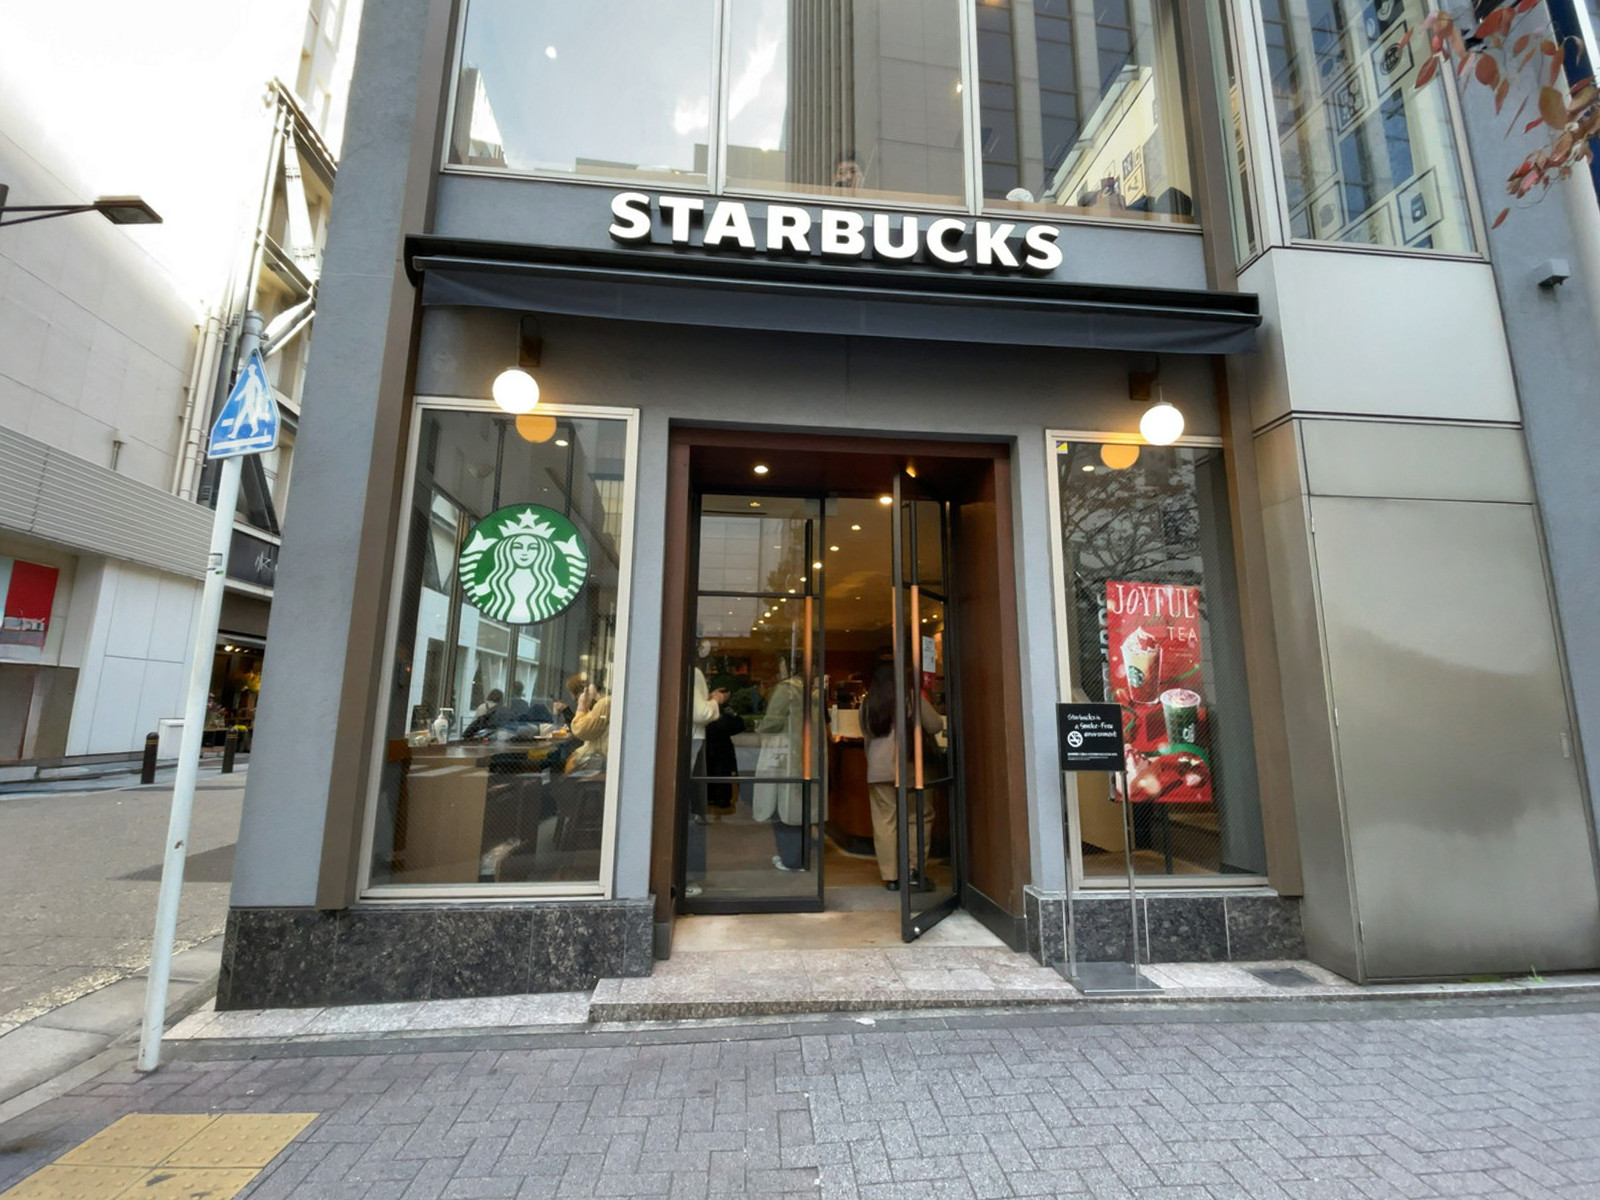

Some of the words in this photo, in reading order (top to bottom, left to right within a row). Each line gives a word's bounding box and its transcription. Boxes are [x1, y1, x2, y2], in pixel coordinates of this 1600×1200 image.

[608, 192, 1063, 271] STARBUCKS
[1112, 584, 1195, 619] JOYFUL
[1166, 626, 1198, 642] TEA
